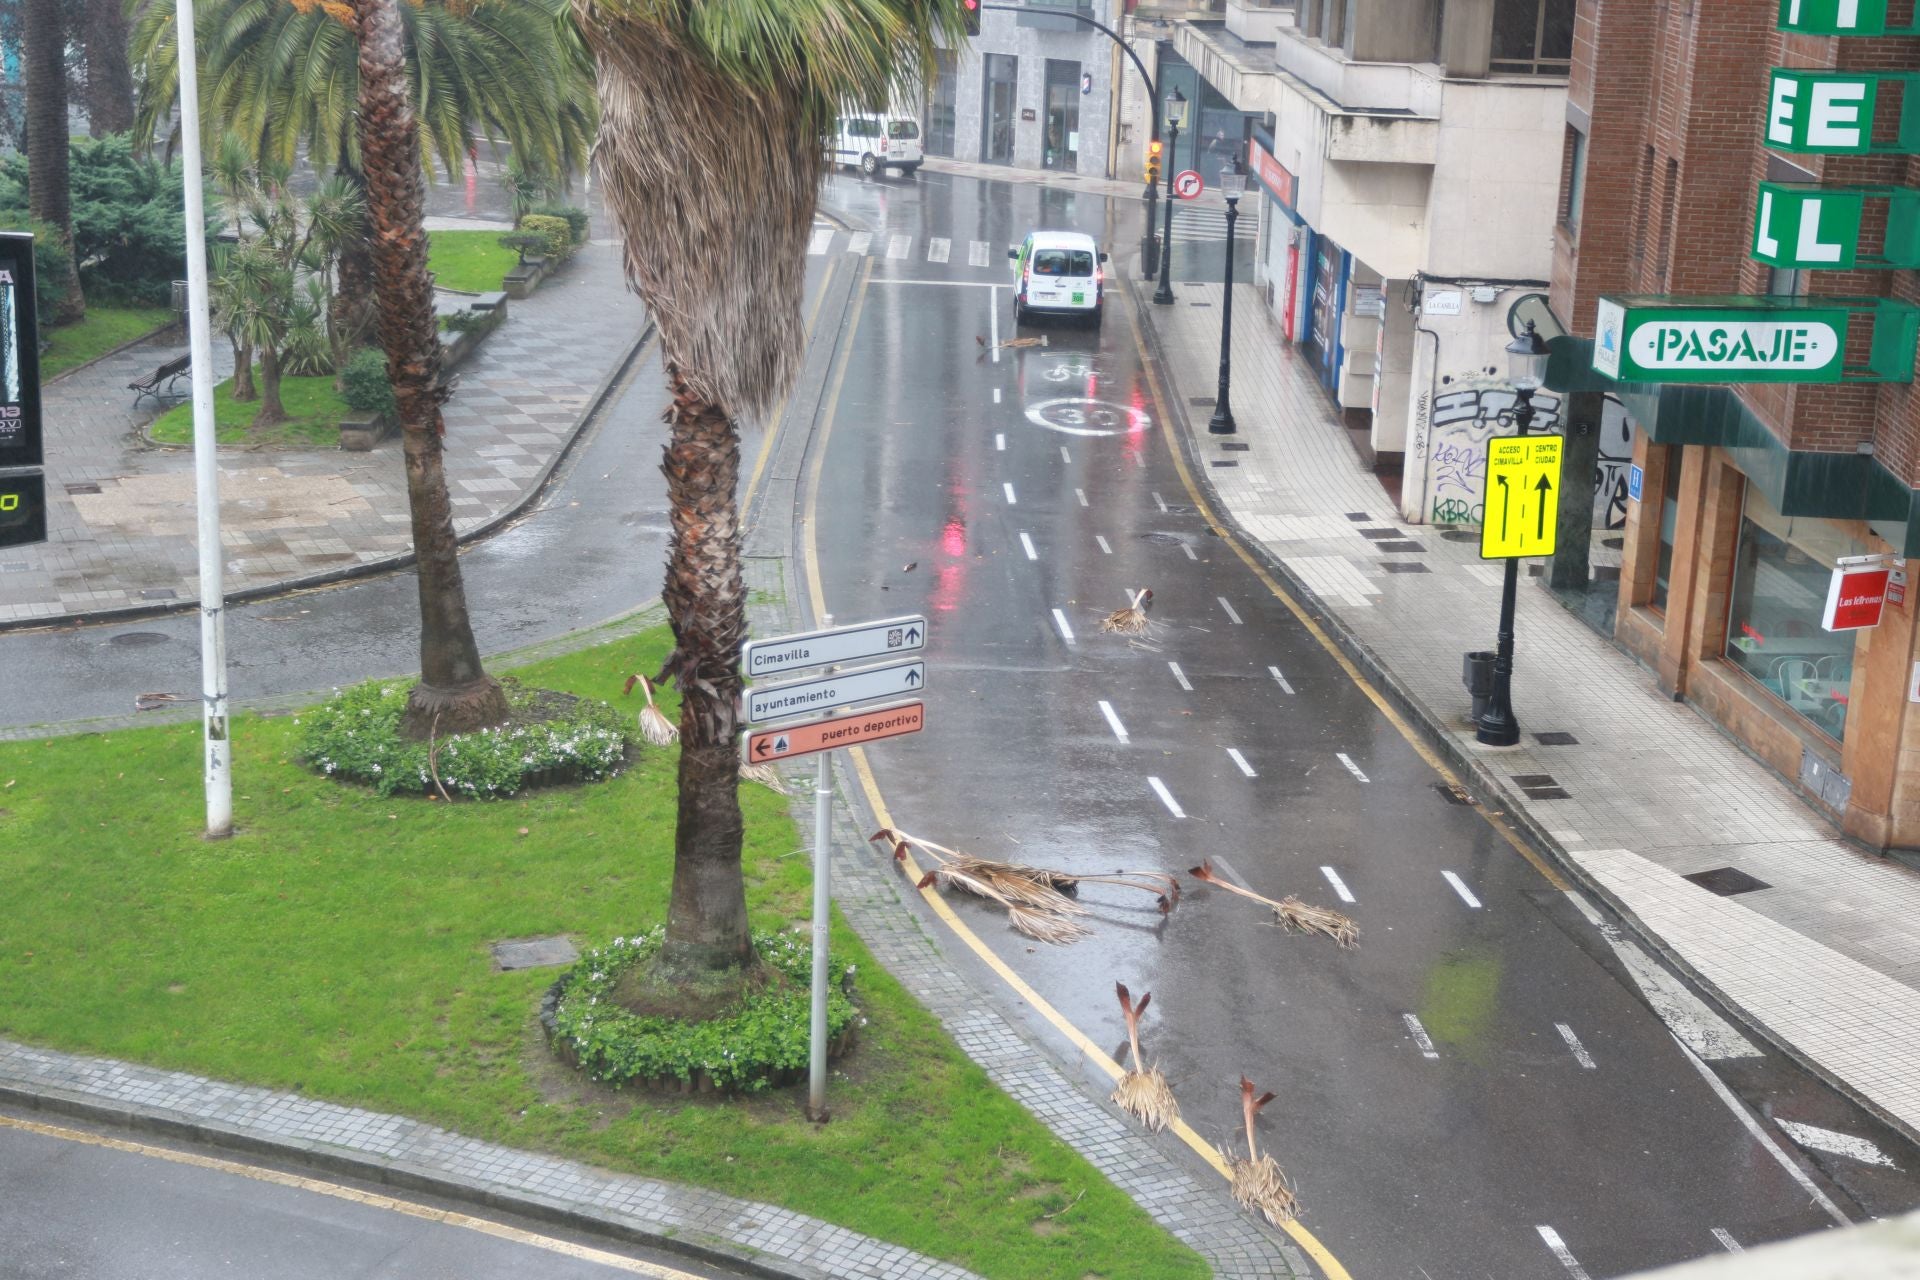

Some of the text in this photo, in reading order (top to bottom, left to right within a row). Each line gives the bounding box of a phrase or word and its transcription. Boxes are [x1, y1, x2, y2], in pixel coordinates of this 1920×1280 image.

[1656, 328, 1808, 362] PASAJE
[1498, 446, 1521, 454] ACCESO
[1535, 444, 1558, 453] CENTRO
[1494, 457, 1523, 466] CIMAVILLA
[1535, 456, 1556, 464] CIUDAD
[1632, 469, 1640, 488] H
[754, 648, 810, 666] Cimavilla
[755, 689, 836, 711] ayuntamiento
[821, 715, 918, 743] puerto deportivo
